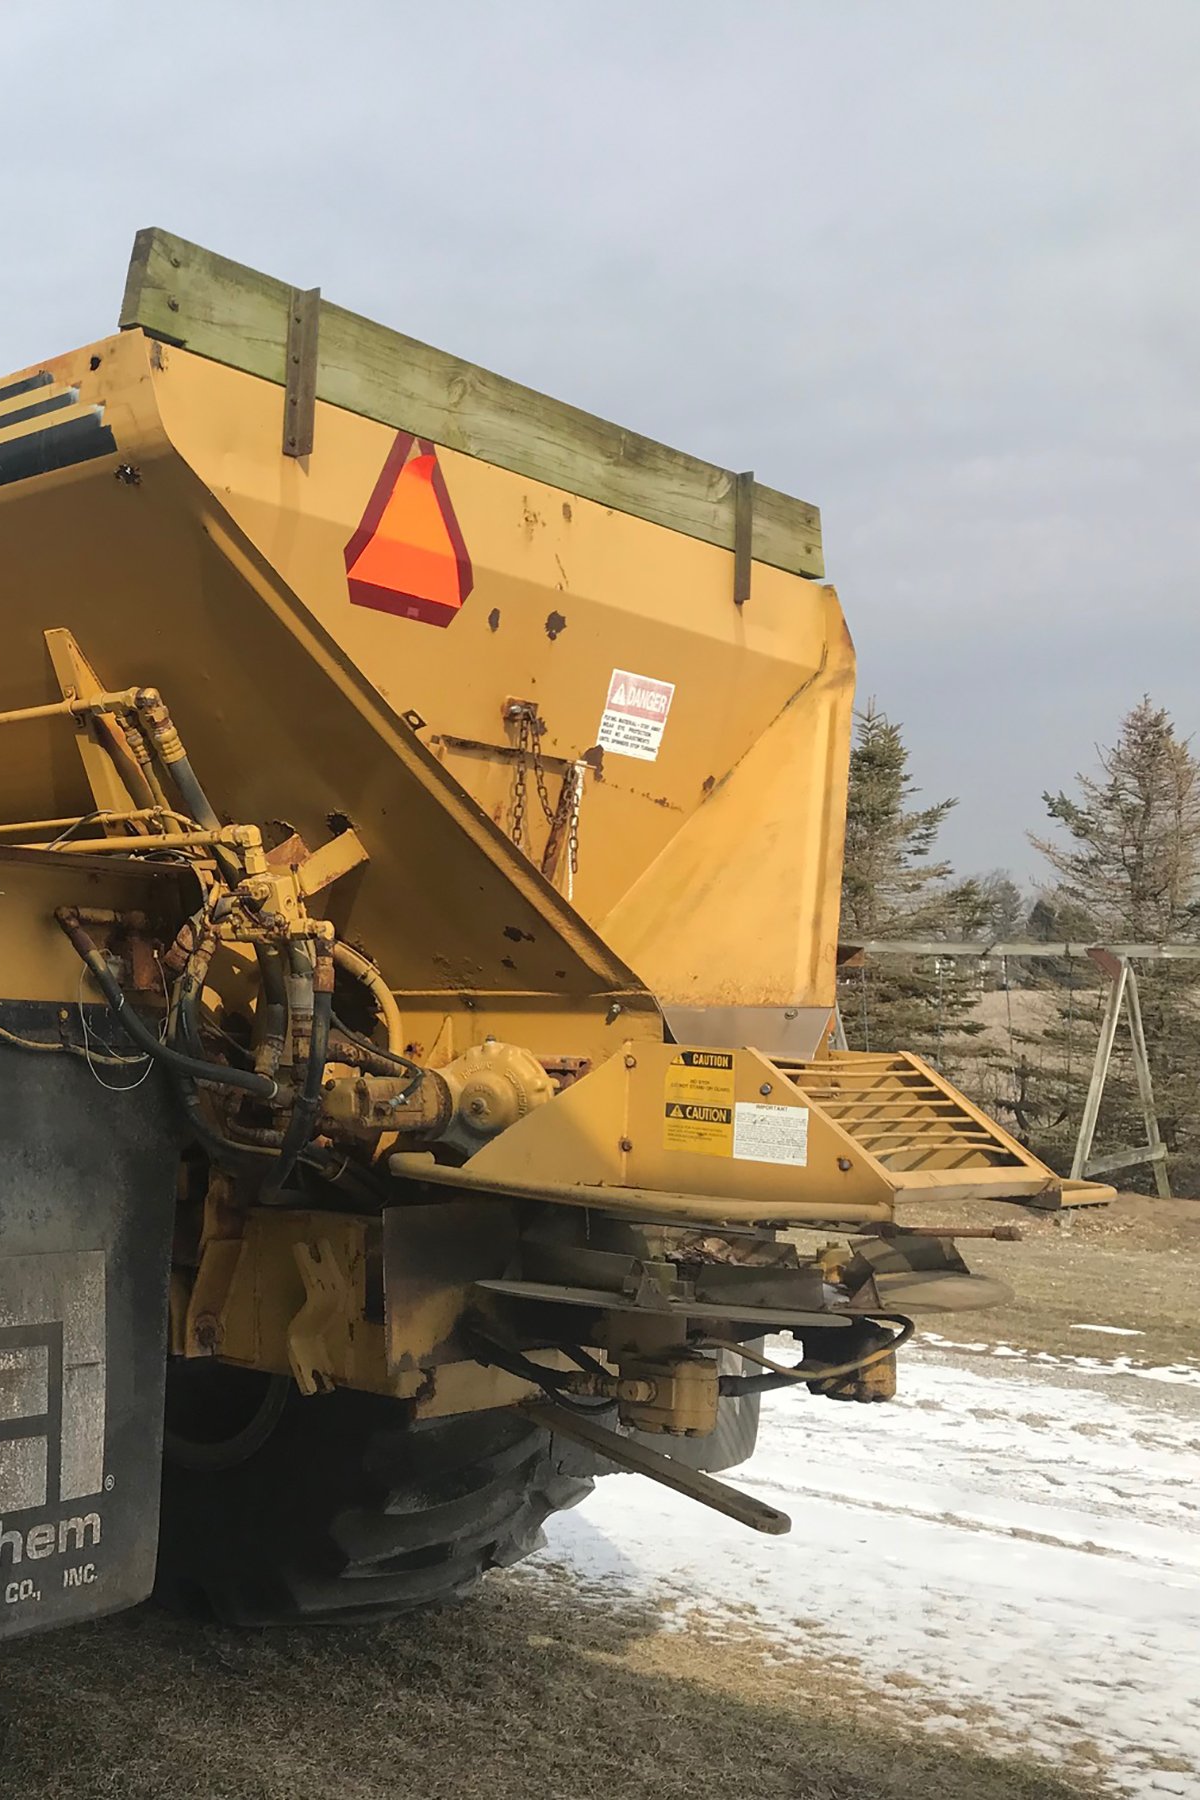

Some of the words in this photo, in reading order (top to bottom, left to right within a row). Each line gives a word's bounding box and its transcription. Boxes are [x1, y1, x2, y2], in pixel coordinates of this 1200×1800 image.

[628, 686, 667, 713] DANGER
[693, 1053, 729, 1068] CAUTION
[686, 1107, 726, 1122] CAUTION
[756, 1104, 788, 1112] IMPORTANT
[63, 1563, 98, 1588] INC.
